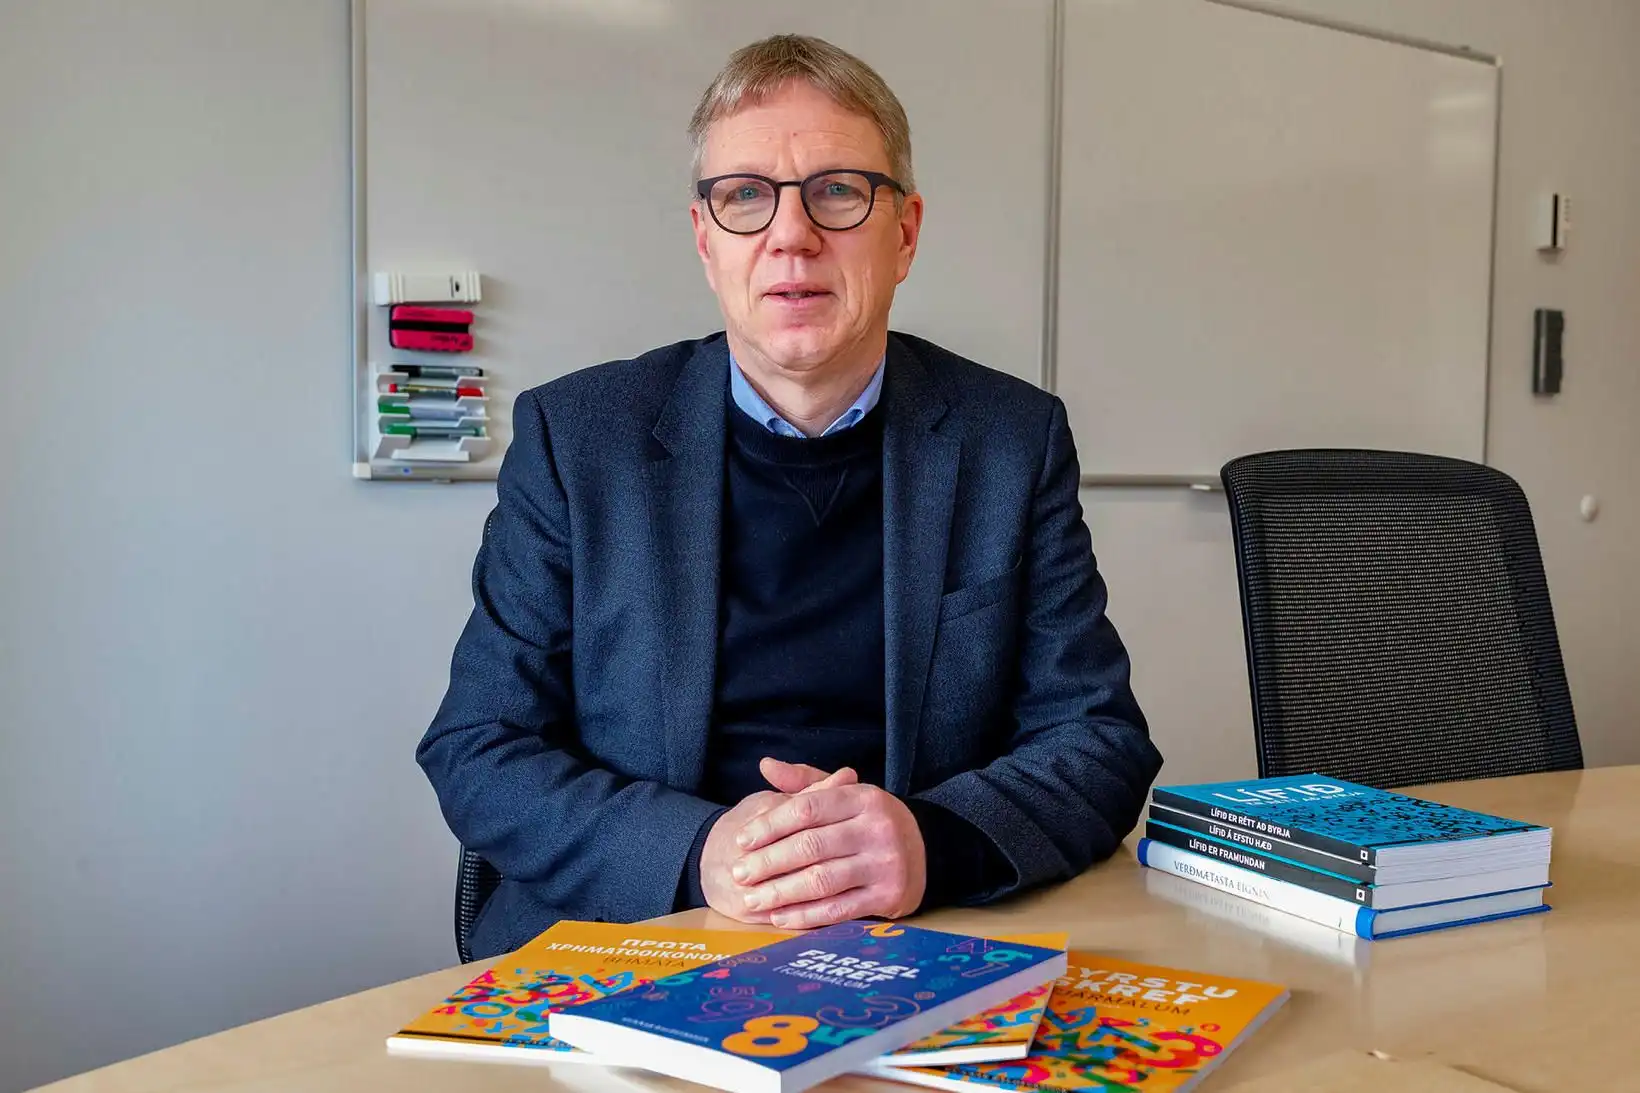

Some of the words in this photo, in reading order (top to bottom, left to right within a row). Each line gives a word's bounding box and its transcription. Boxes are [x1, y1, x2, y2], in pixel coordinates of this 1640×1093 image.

[1209, 824, 1226, 837] LÍFIÐ
[1226, 829, 1233, 840] Á
[1233, 834, 1254, 845] EFSTU
[1254, 838, 1272, 851] HÆÐ
[1210, 807, 1228, 820] LÍFIÐ
[1228, 813, 1238, 824] ER
[1238, 816, 1256, 829] RÉTT
[1256, 821, 1267, 831] AÐ
[1267, 824, 1291, 838] BYRJA
[1189, 838, 1208, 852] LÍFIÐ
[1208, 845, 1218, 856] ER
[1219, 849, 1266, 870] FRAMUNDAN
[1174, 860, 1235, 888] VERÐMÆTASTA
[788, 959, 895, 982] SKREF
[798, 949, 920, 979] FARSÆL
[1067, 965, 1238, 998] YRSTU
